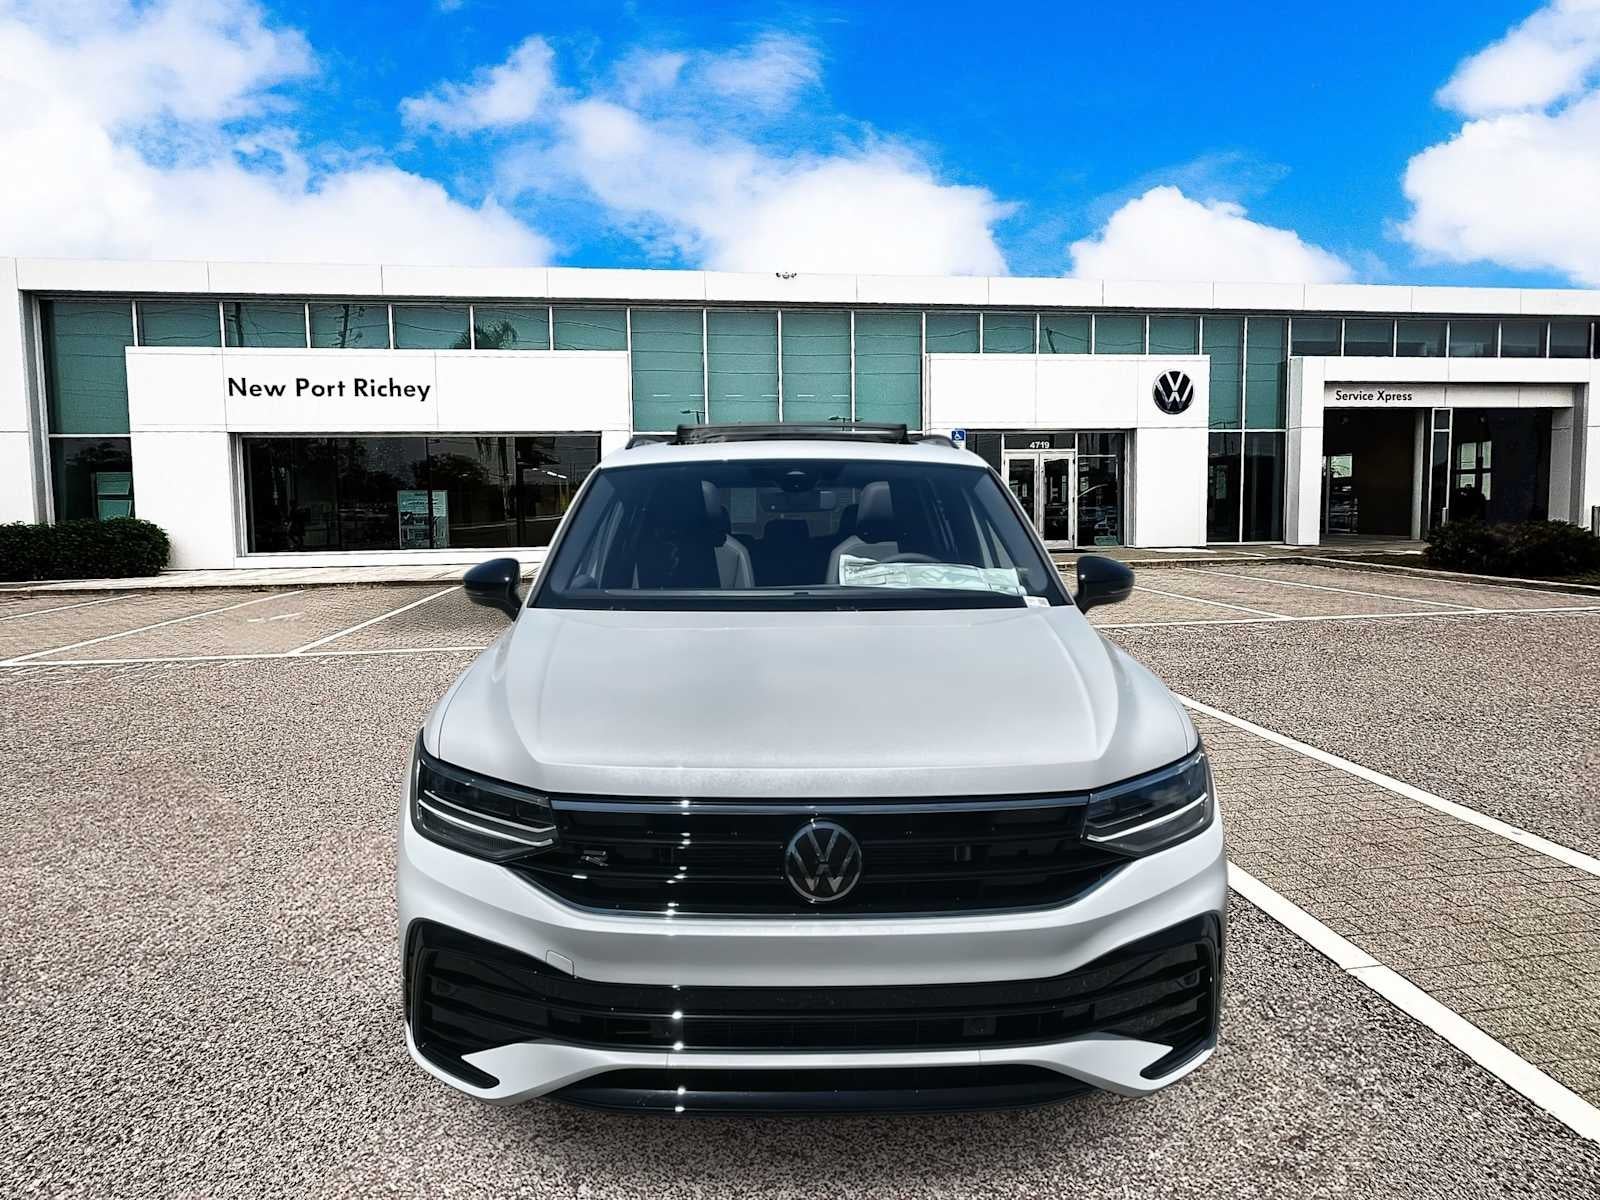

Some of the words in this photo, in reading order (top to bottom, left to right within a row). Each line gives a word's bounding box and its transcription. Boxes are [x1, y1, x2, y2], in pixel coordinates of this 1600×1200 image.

[228, 377, 286, 397] New
[296, 377, 346, 397] Port
[354, 377, 431, 402] Richey
[1335, 390, 1374, 401] Service
[1376, 390, 1413, 403] Xpress
[1030, 441, 1050, 449] 4719
